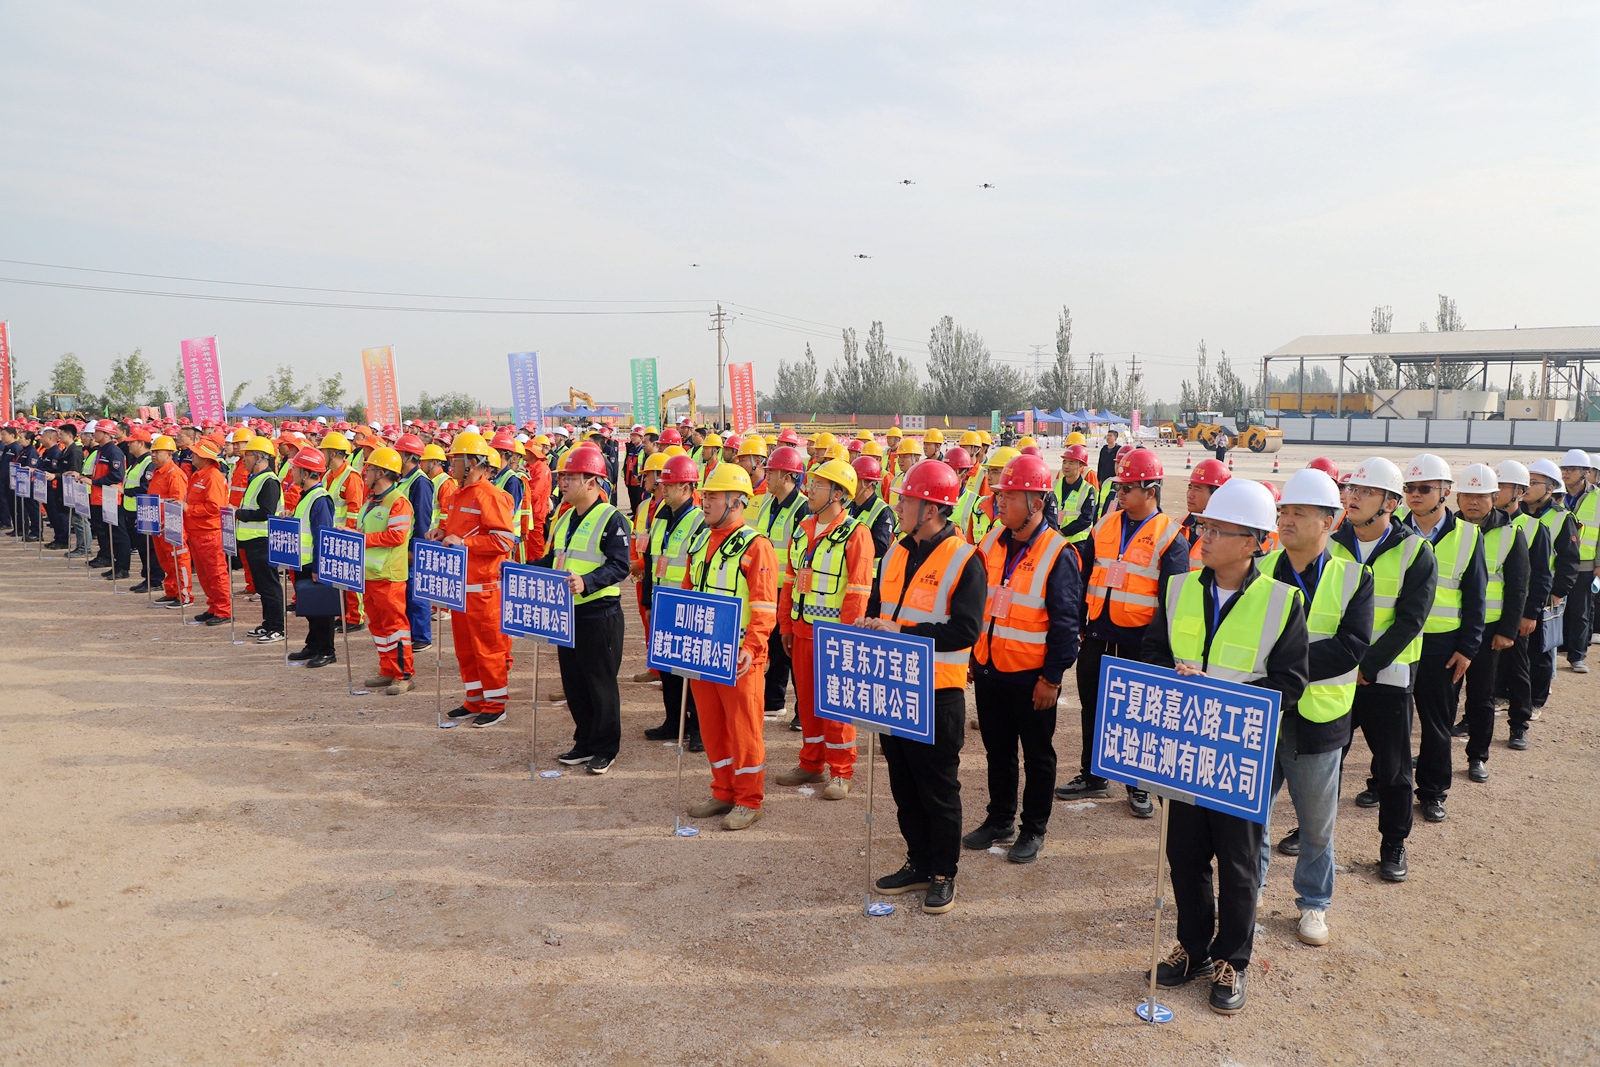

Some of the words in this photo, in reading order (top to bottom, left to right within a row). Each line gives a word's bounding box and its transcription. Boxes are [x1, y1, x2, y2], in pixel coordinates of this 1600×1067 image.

[320, 556, 361, 584] 设工程有限公司
[418, 548, 461, 577] 宁夏新中通建
[415, 571, 463, 602] 设工程有限公司
[508, 574, 566, 606] 固原市凯达公
[504, 600, 569, 636] 路工程有限公司
[653, 629, 733, 672] 建筑工程有限公司
[825, 636, 921, 686] 宁夏东方宝盛
[826, 673, 920, 726] 建设有限公司
[1108, 676, 1265, 752] 宁夏路嘉公路工程
[1103, 721, 1260, 802] 试验监测有限公司
